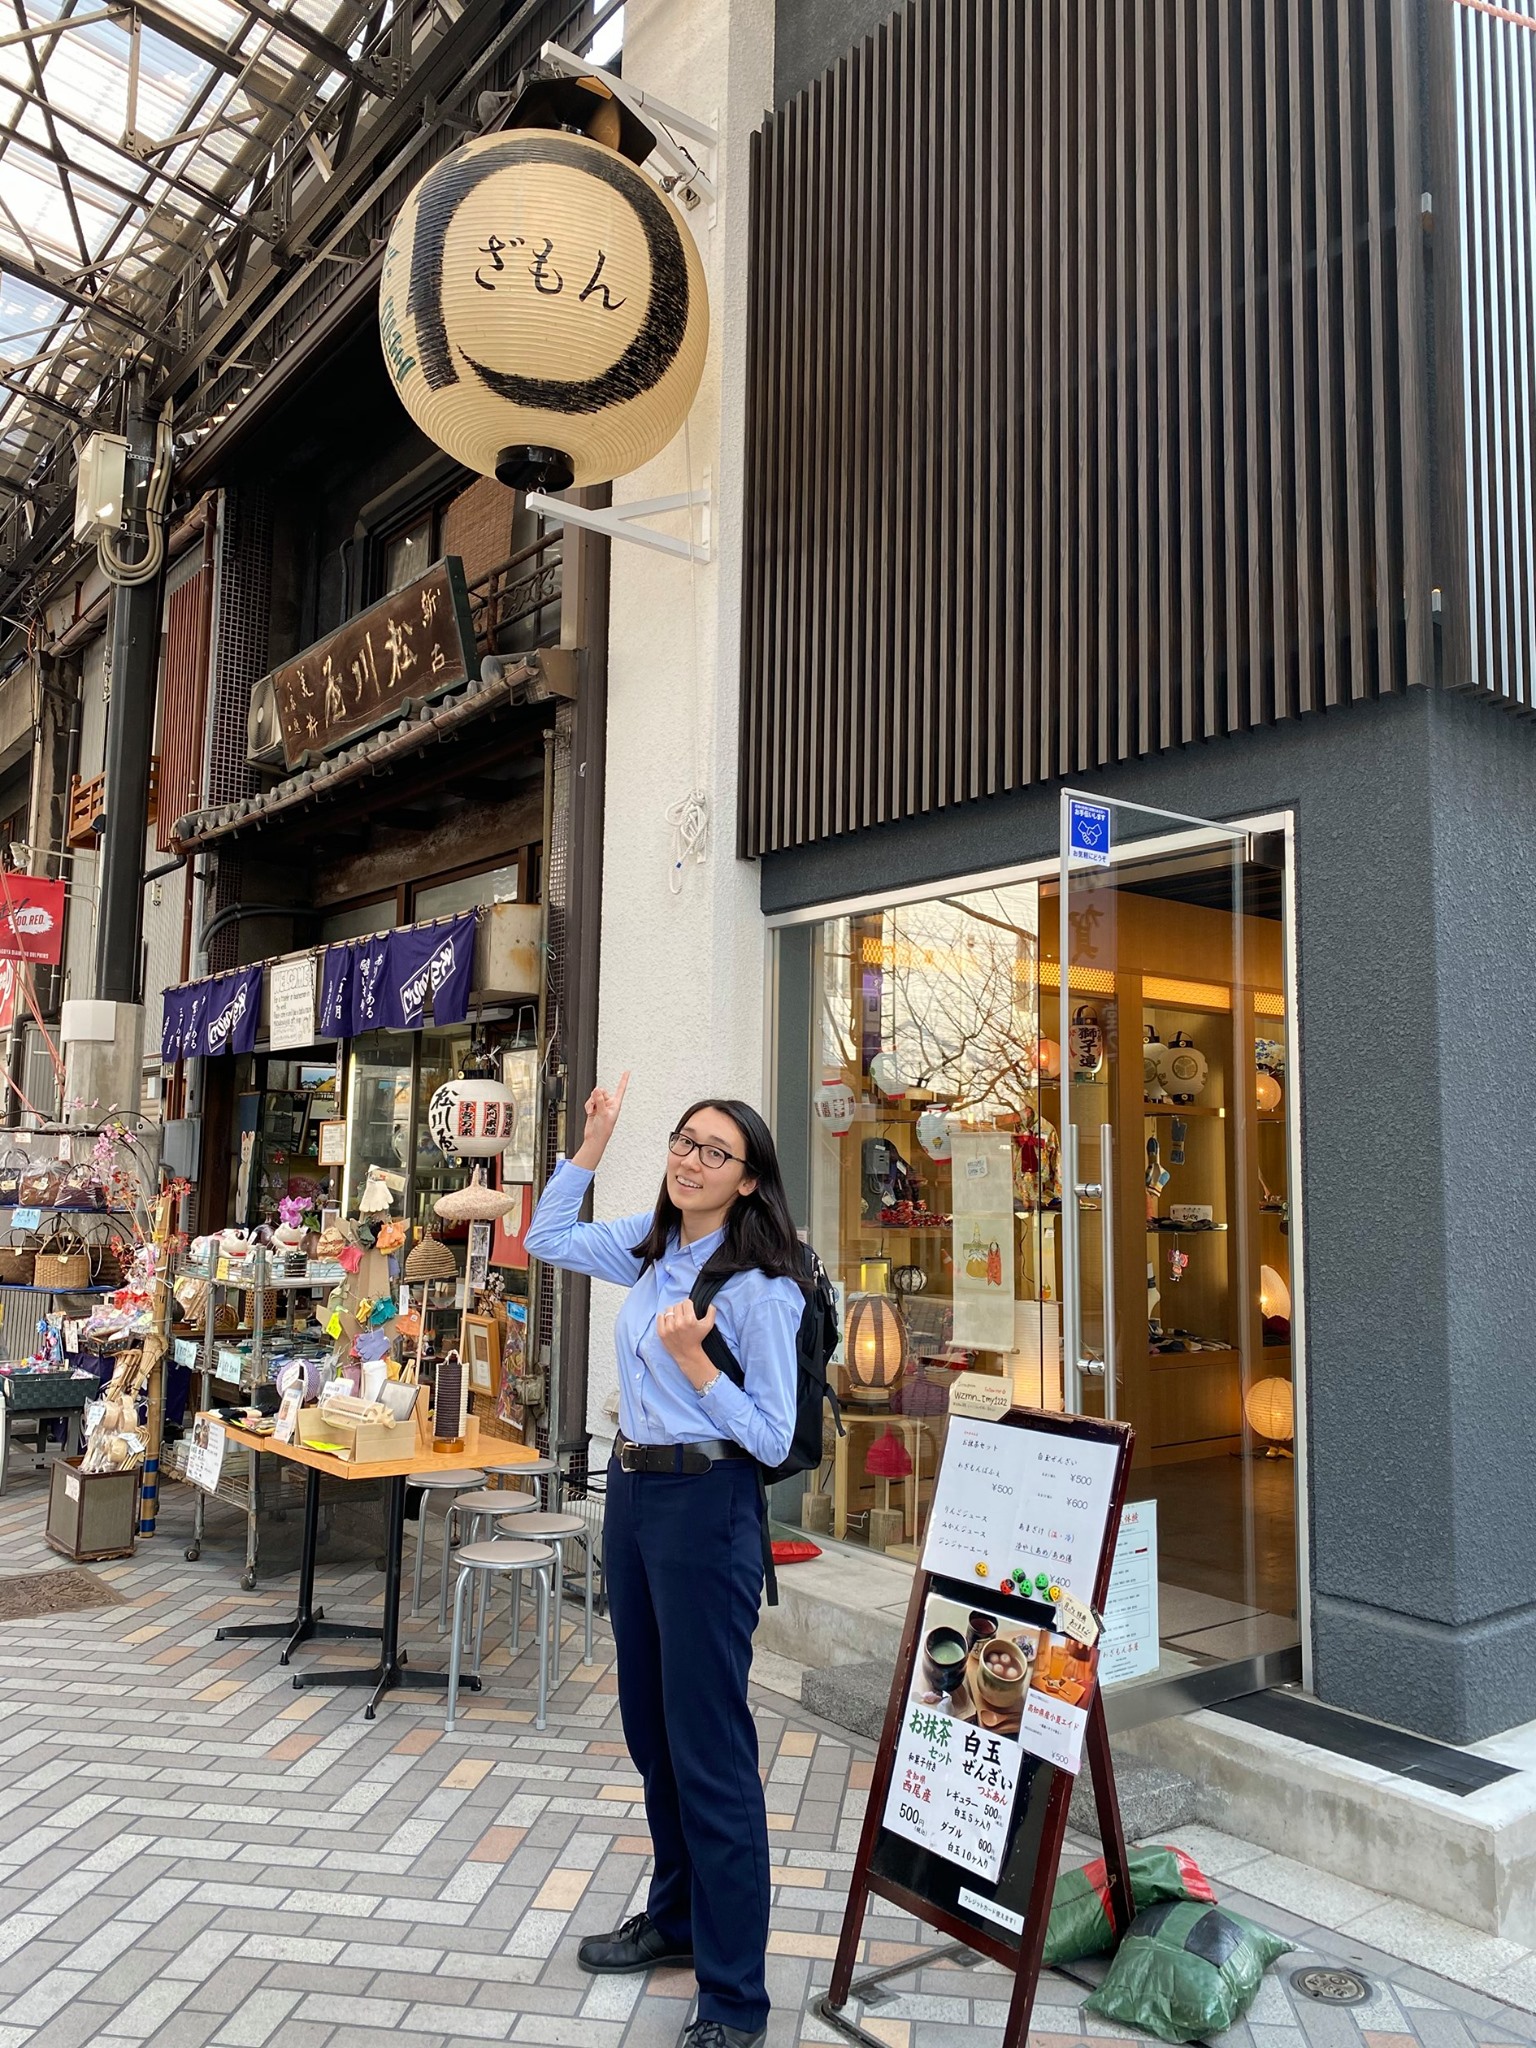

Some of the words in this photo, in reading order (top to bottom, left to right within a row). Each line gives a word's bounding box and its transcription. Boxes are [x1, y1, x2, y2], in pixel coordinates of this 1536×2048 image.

[431, 1086, 459, 1152] 松川屋
[991, 1483, 1014, 1496] ¥500
[1070, 1473, 1093, 1486] ¥500
[1066, 1497, 1089, 1510] ¥600
[1049, 1573, 1071, 1588] ¥400
[909, 1709, 953, 1748] お抹茶
[928, 1746, 953, 1766] セット
[964, 1729, 1002, 1766] 白玉
[1051, 1750, 1069, 1765] ¥500
[908, 1752, 937, 1772] 和菓子付き
[906, 1768, 926, 1785] 愛知県
[962, 1759, 1013, 1791] ぜんざい
[902, 1779, 932, 1804] 西尾産
[946, 1788, 978, 1808] レギュラー
[977, 1785, 1008, 1806] つぶあん
[940, 1821, 963, 1839] ダブル
